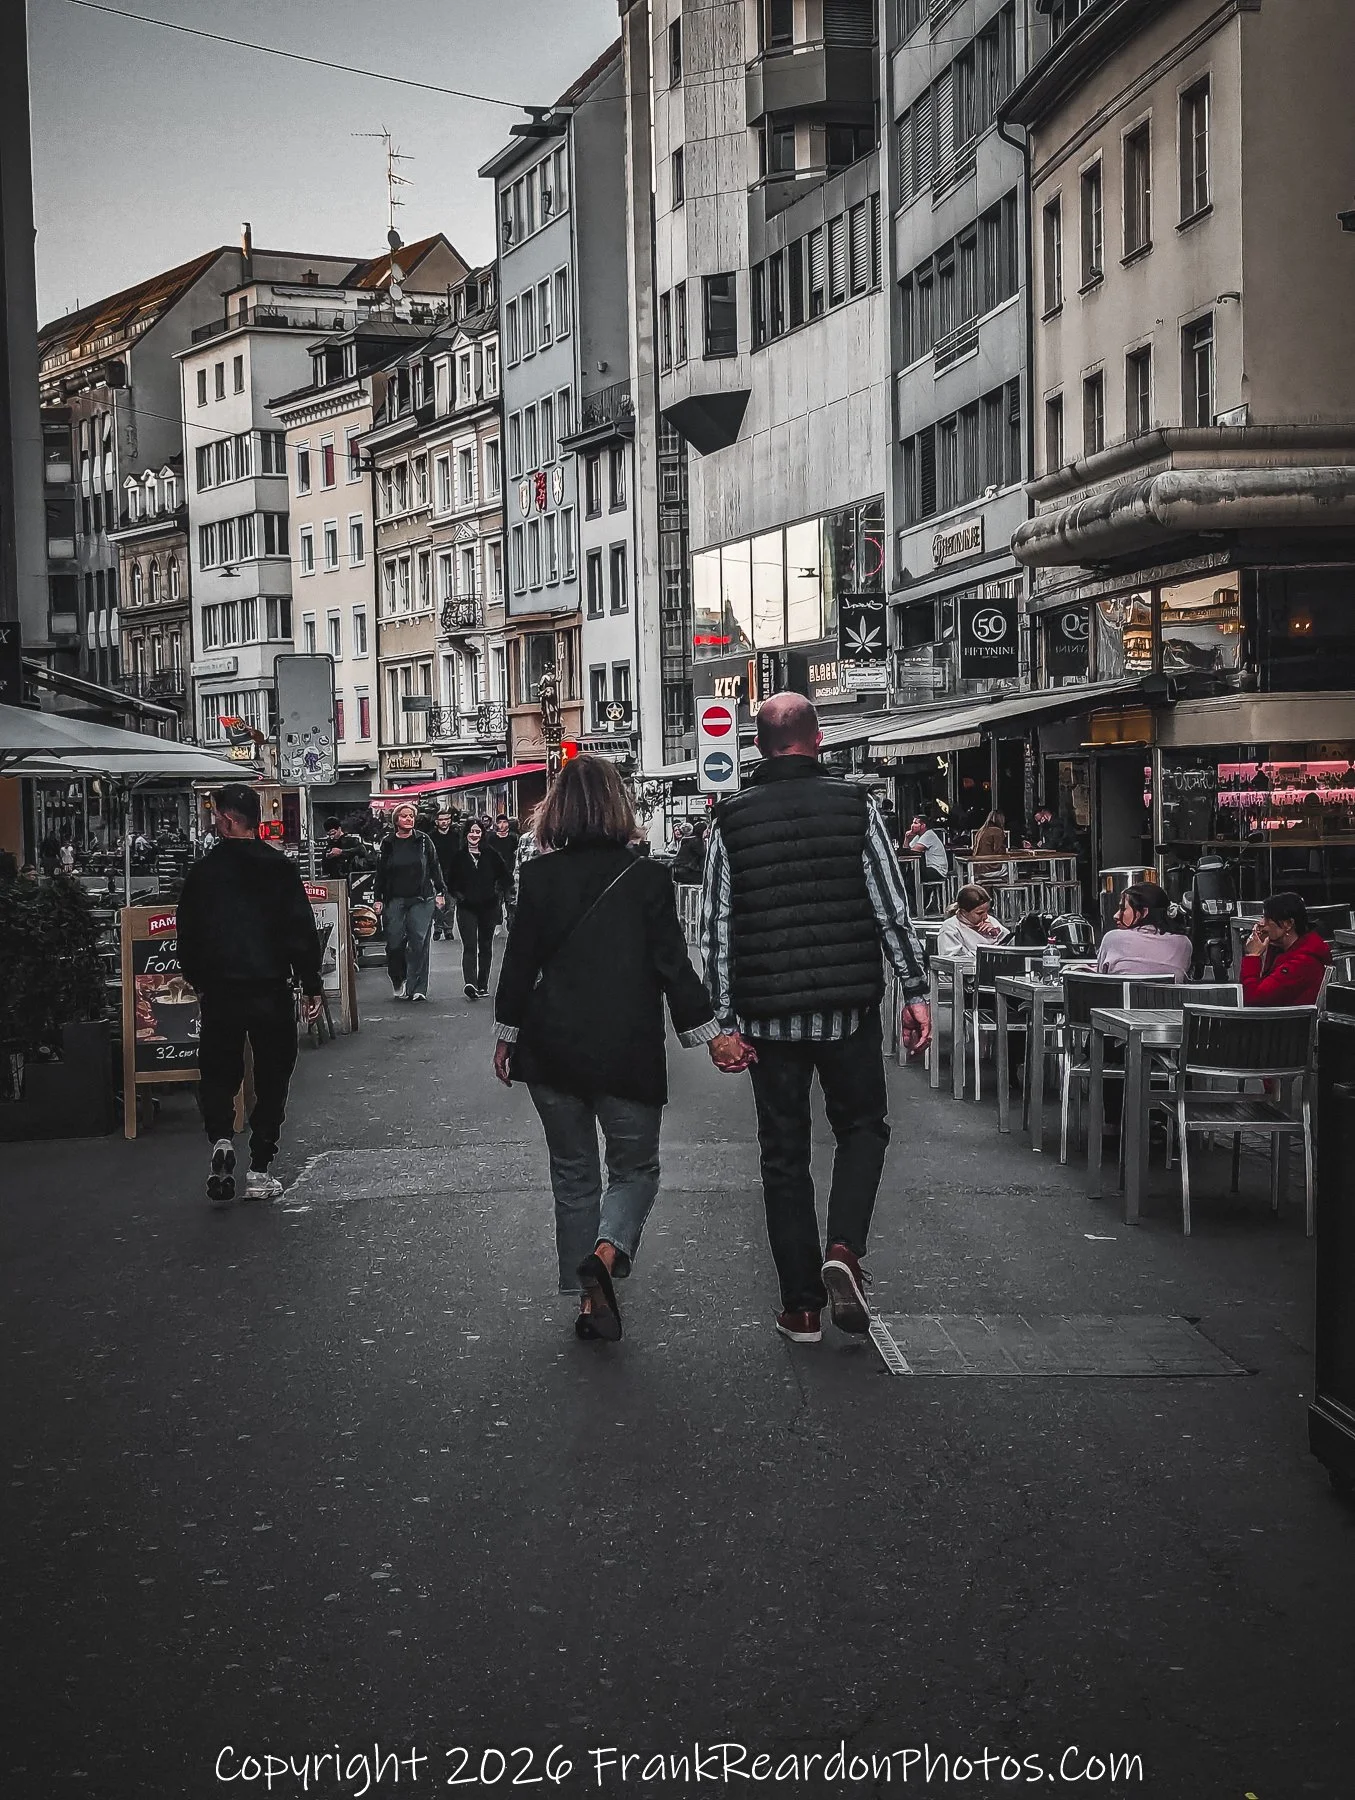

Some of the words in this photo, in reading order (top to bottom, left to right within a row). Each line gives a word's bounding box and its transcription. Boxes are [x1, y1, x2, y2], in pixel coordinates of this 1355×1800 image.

[808, 661, 838, 683] BLACK
[714, 675, 741, 698] KFC
[150, 916, 177, 931] RAM
